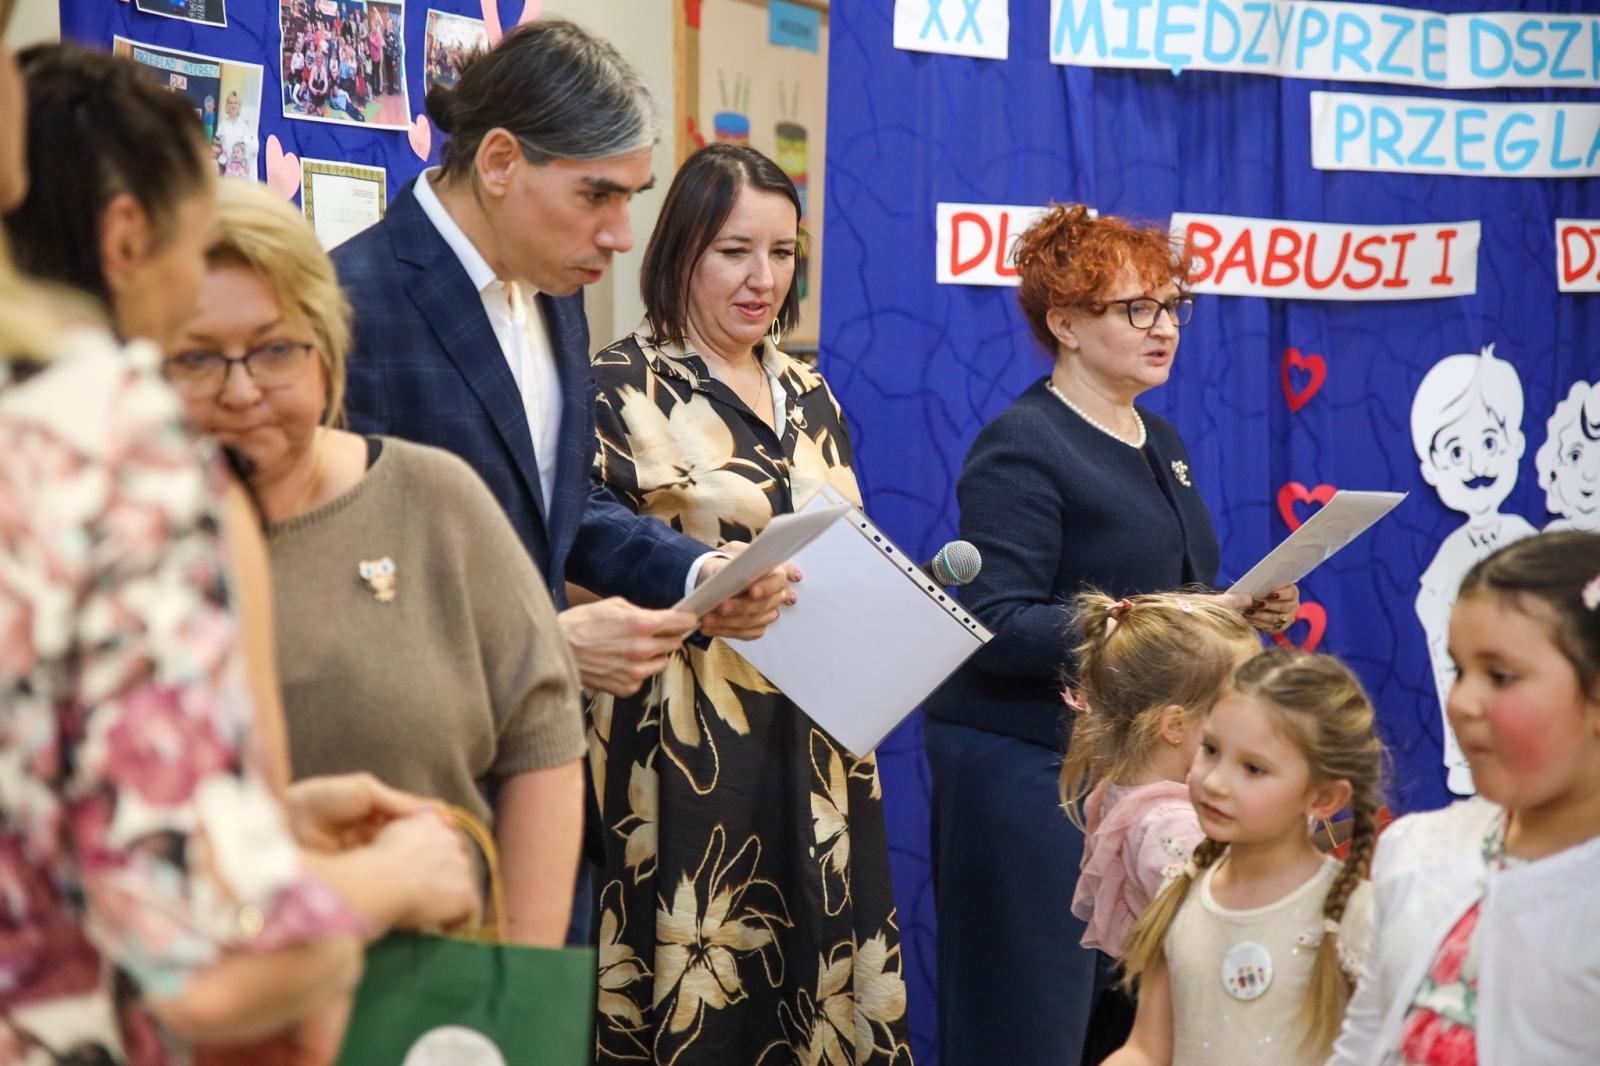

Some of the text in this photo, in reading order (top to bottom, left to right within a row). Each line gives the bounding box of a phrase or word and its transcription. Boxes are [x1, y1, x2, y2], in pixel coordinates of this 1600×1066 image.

[918, 0, 984, 45] XX
[950, 211, 1600, 290] DL BABUSI I D
